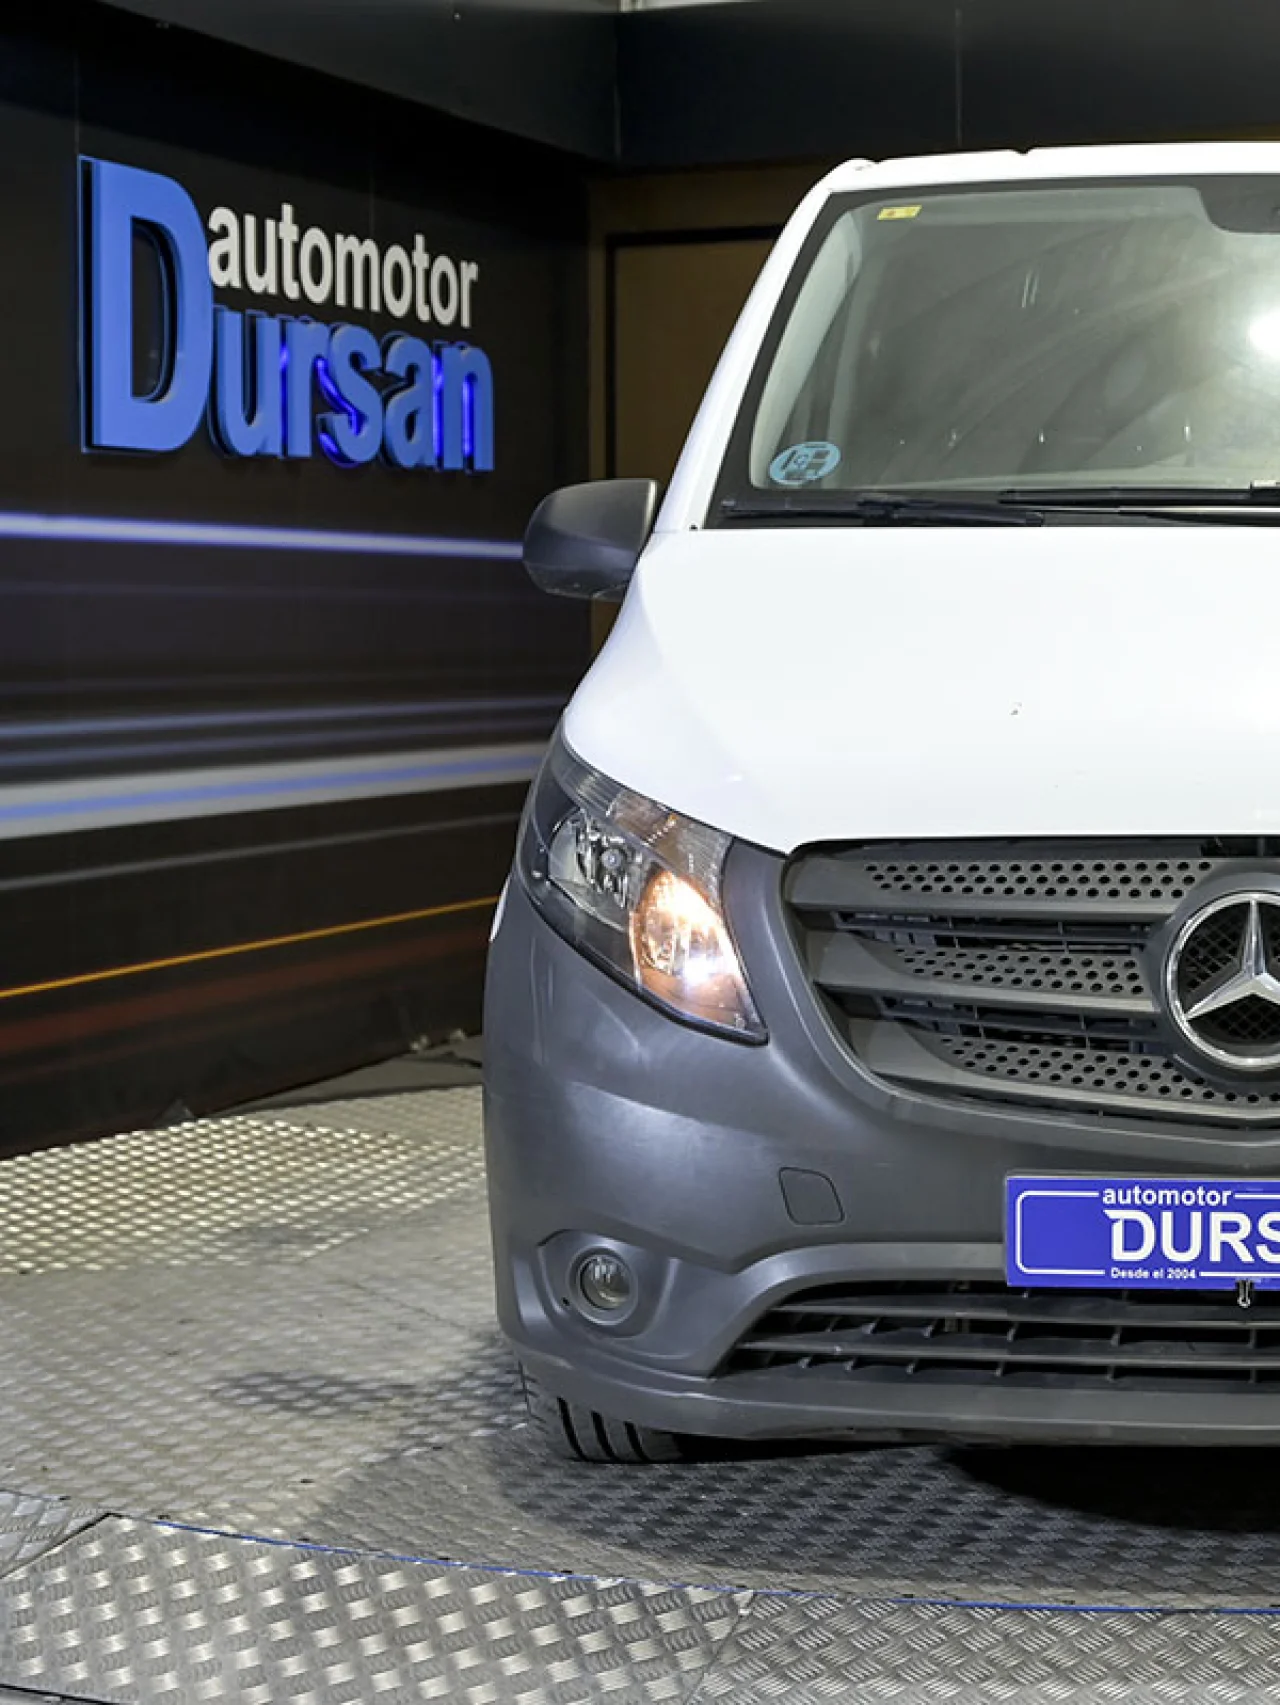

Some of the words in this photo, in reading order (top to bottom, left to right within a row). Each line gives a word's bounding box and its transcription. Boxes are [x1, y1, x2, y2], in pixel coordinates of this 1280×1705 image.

[208, 202, 479, 328] automotor
[77, 153, 495, 474] Dursan
[1102, 1185, 1233, 1206] automotor
[1111, 1266, 1150, 1280] Desde
[1152, 1266, 1164, 1280] el
[1166, 1267, 1197, 1280] 2004
